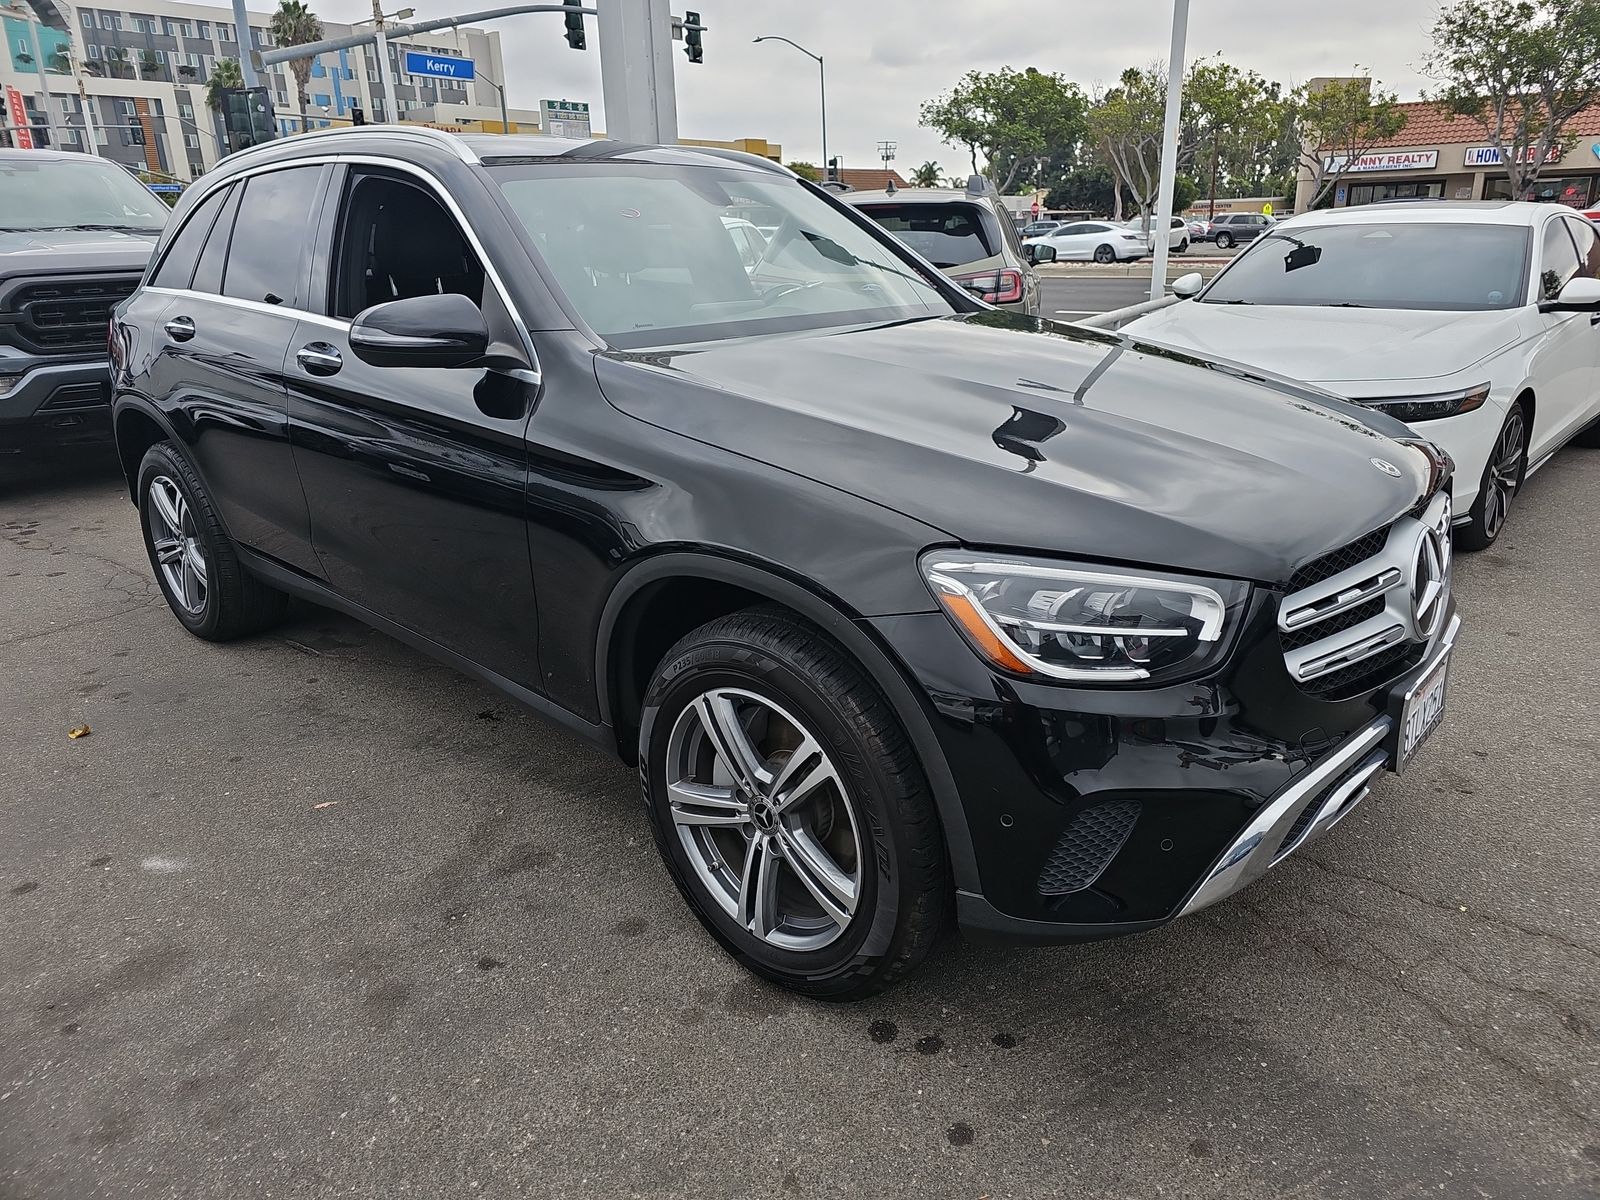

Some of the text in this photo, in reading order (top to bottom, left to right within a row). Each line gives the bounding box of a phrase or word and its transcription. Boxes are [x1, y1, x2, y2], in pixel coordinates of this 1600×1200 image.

[426, 59, 455, 76] Kerry
[1351, 153, 1433, 167] UNNY REALTY
